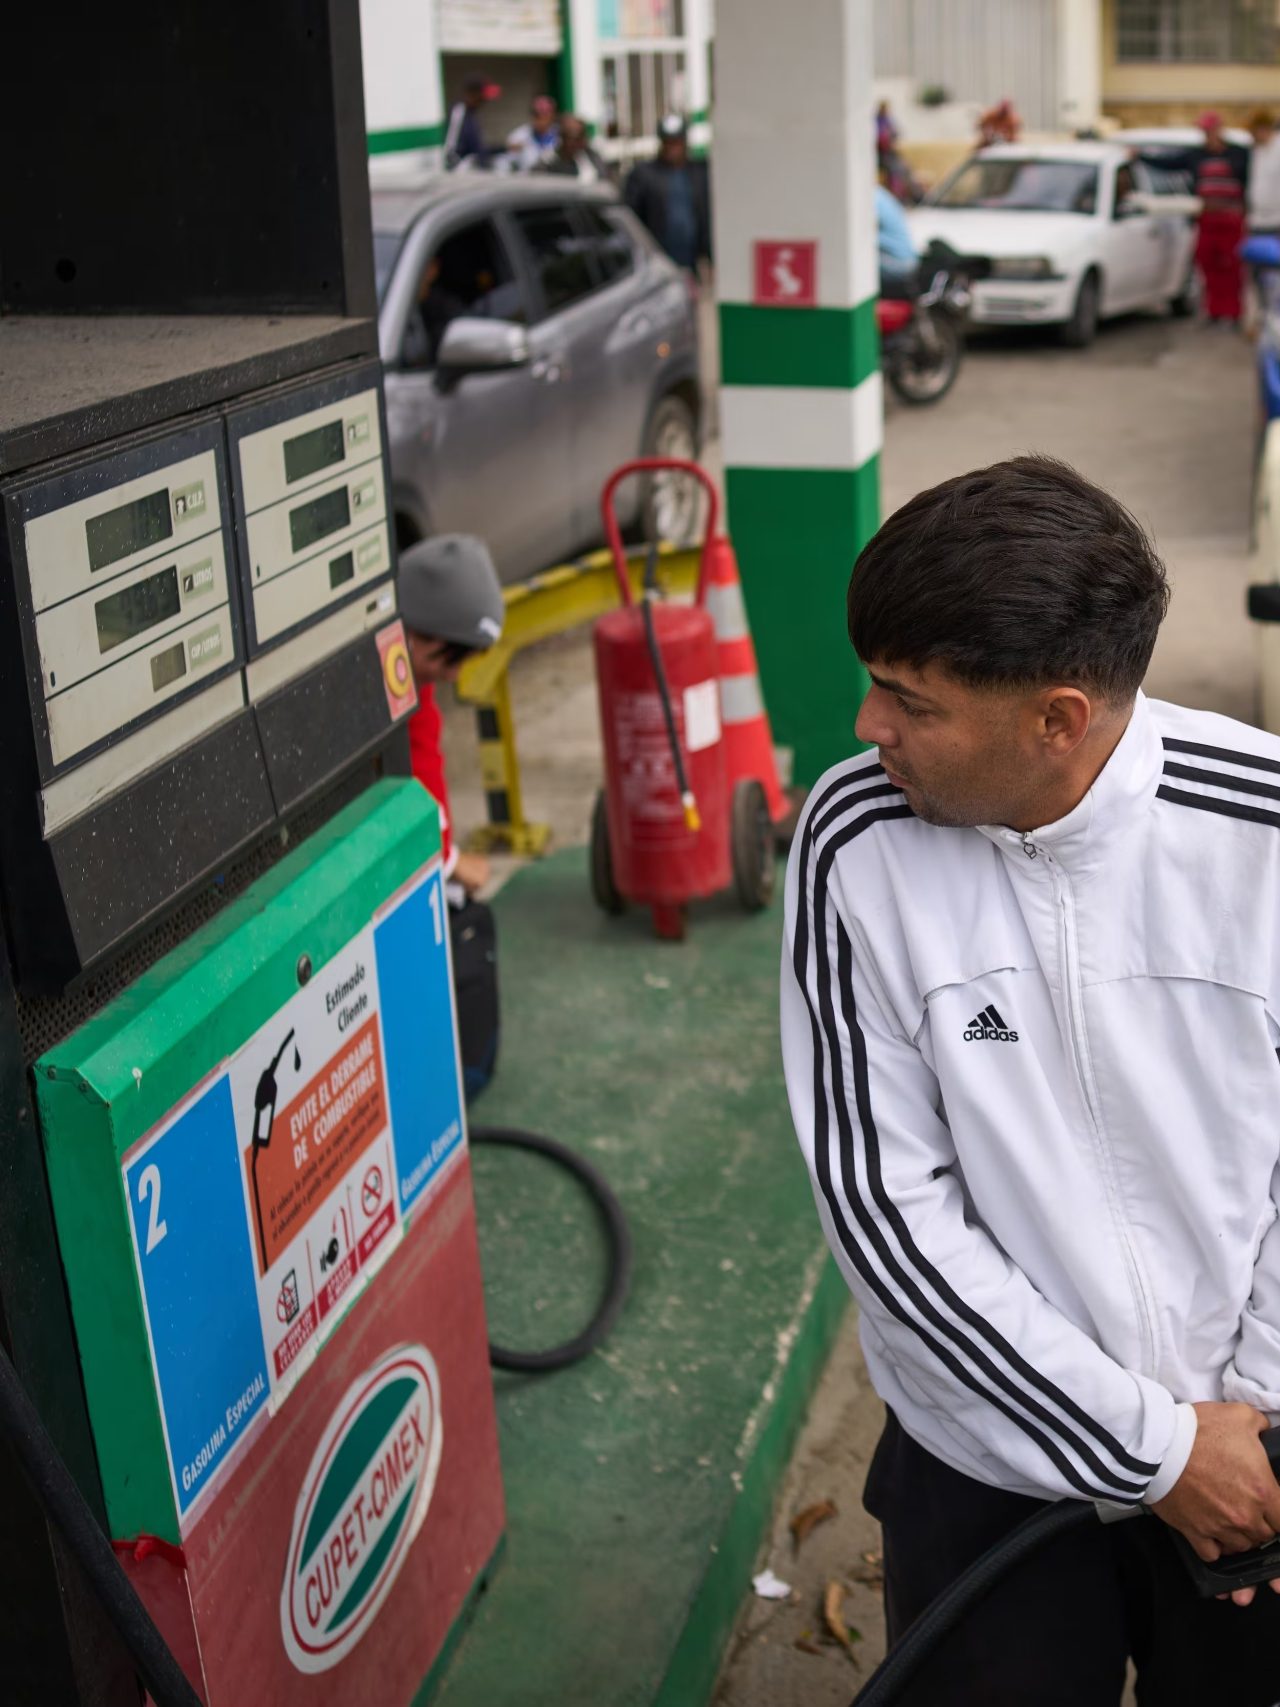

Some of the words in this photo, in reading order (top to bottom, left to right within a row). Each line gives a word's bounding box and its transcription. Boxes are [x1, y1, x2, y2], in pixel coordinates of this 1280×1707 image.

[429, 881, 442, 945] 1
[326, 963, 365, 1015] Estimado
[338, 993, 367, 1032] Cliente
[963, 1027, 1019, 1042] adidas
[289, 1091, 318, 1142] EVITE
[318, 1077, 330, 1111] EL
[330, 1030, 373, 1097] DERRAME
[293, 1134, 308, 1171] DE
[312, 1057, 376, 1149] COMBUSTIBLE
[138, 1164, 167, 1255] 2
[182, 1423, 226, 1491] GASOLINA
[226, 1372, 264, 1433] ESPECIAL
[305, 1404, 424, 1627] CUPET-CIMEX
